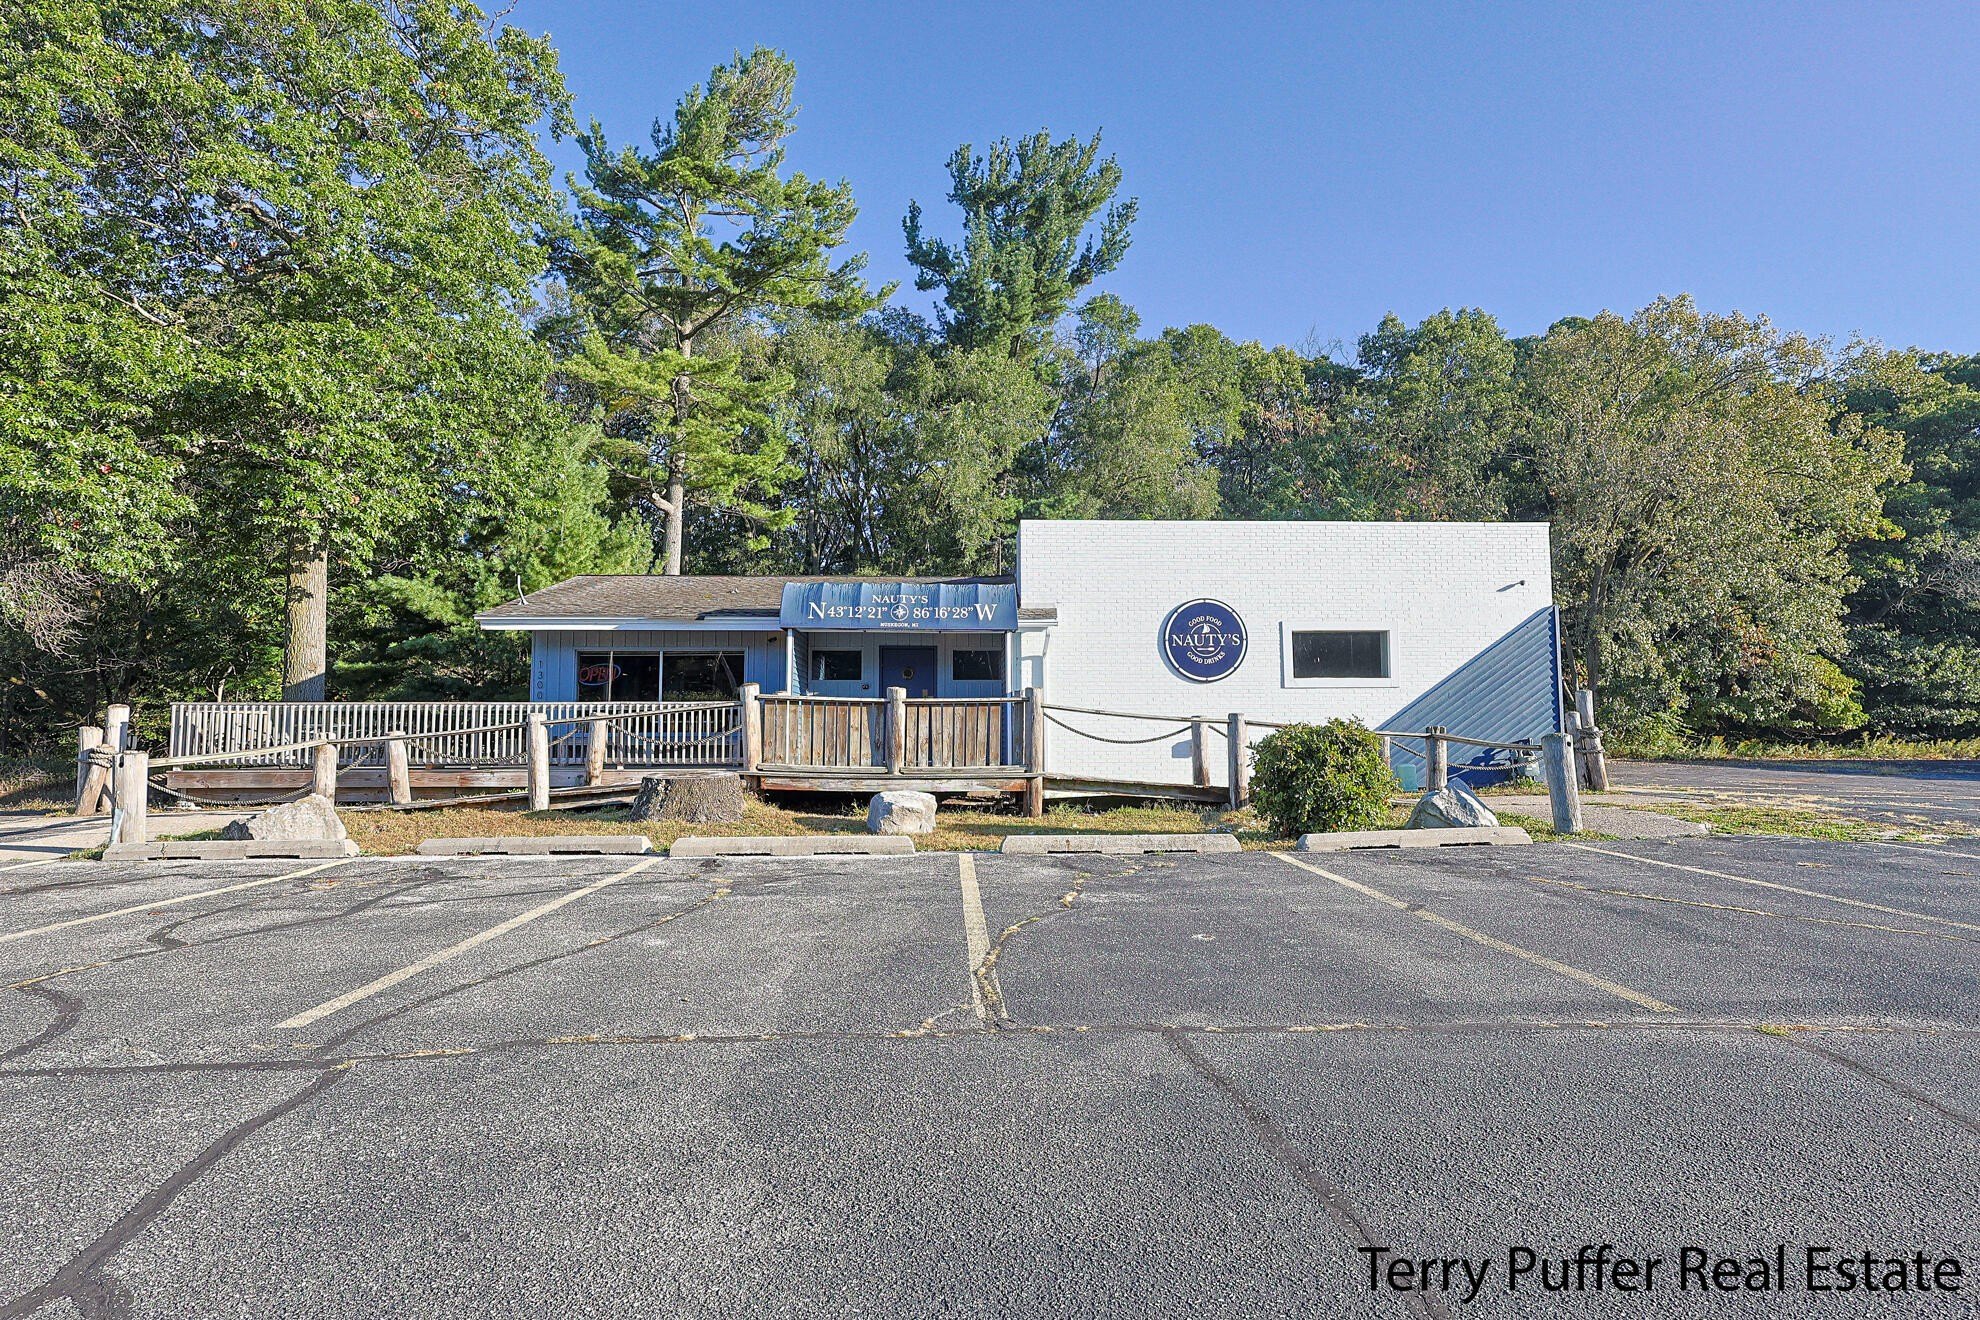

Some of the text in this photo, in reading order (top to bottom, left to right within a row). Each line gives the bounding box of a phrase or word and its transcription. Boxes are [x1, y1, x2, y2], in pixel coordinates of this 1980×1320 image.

[871, 594, 929, 604] NAUTY'S
[1188, 615, 1222, 627] GOOD FOOD
[1172, 633, 1241, 647] NAUTY'S
[1186, 651, 1226, 665] GOOD DRINKS
